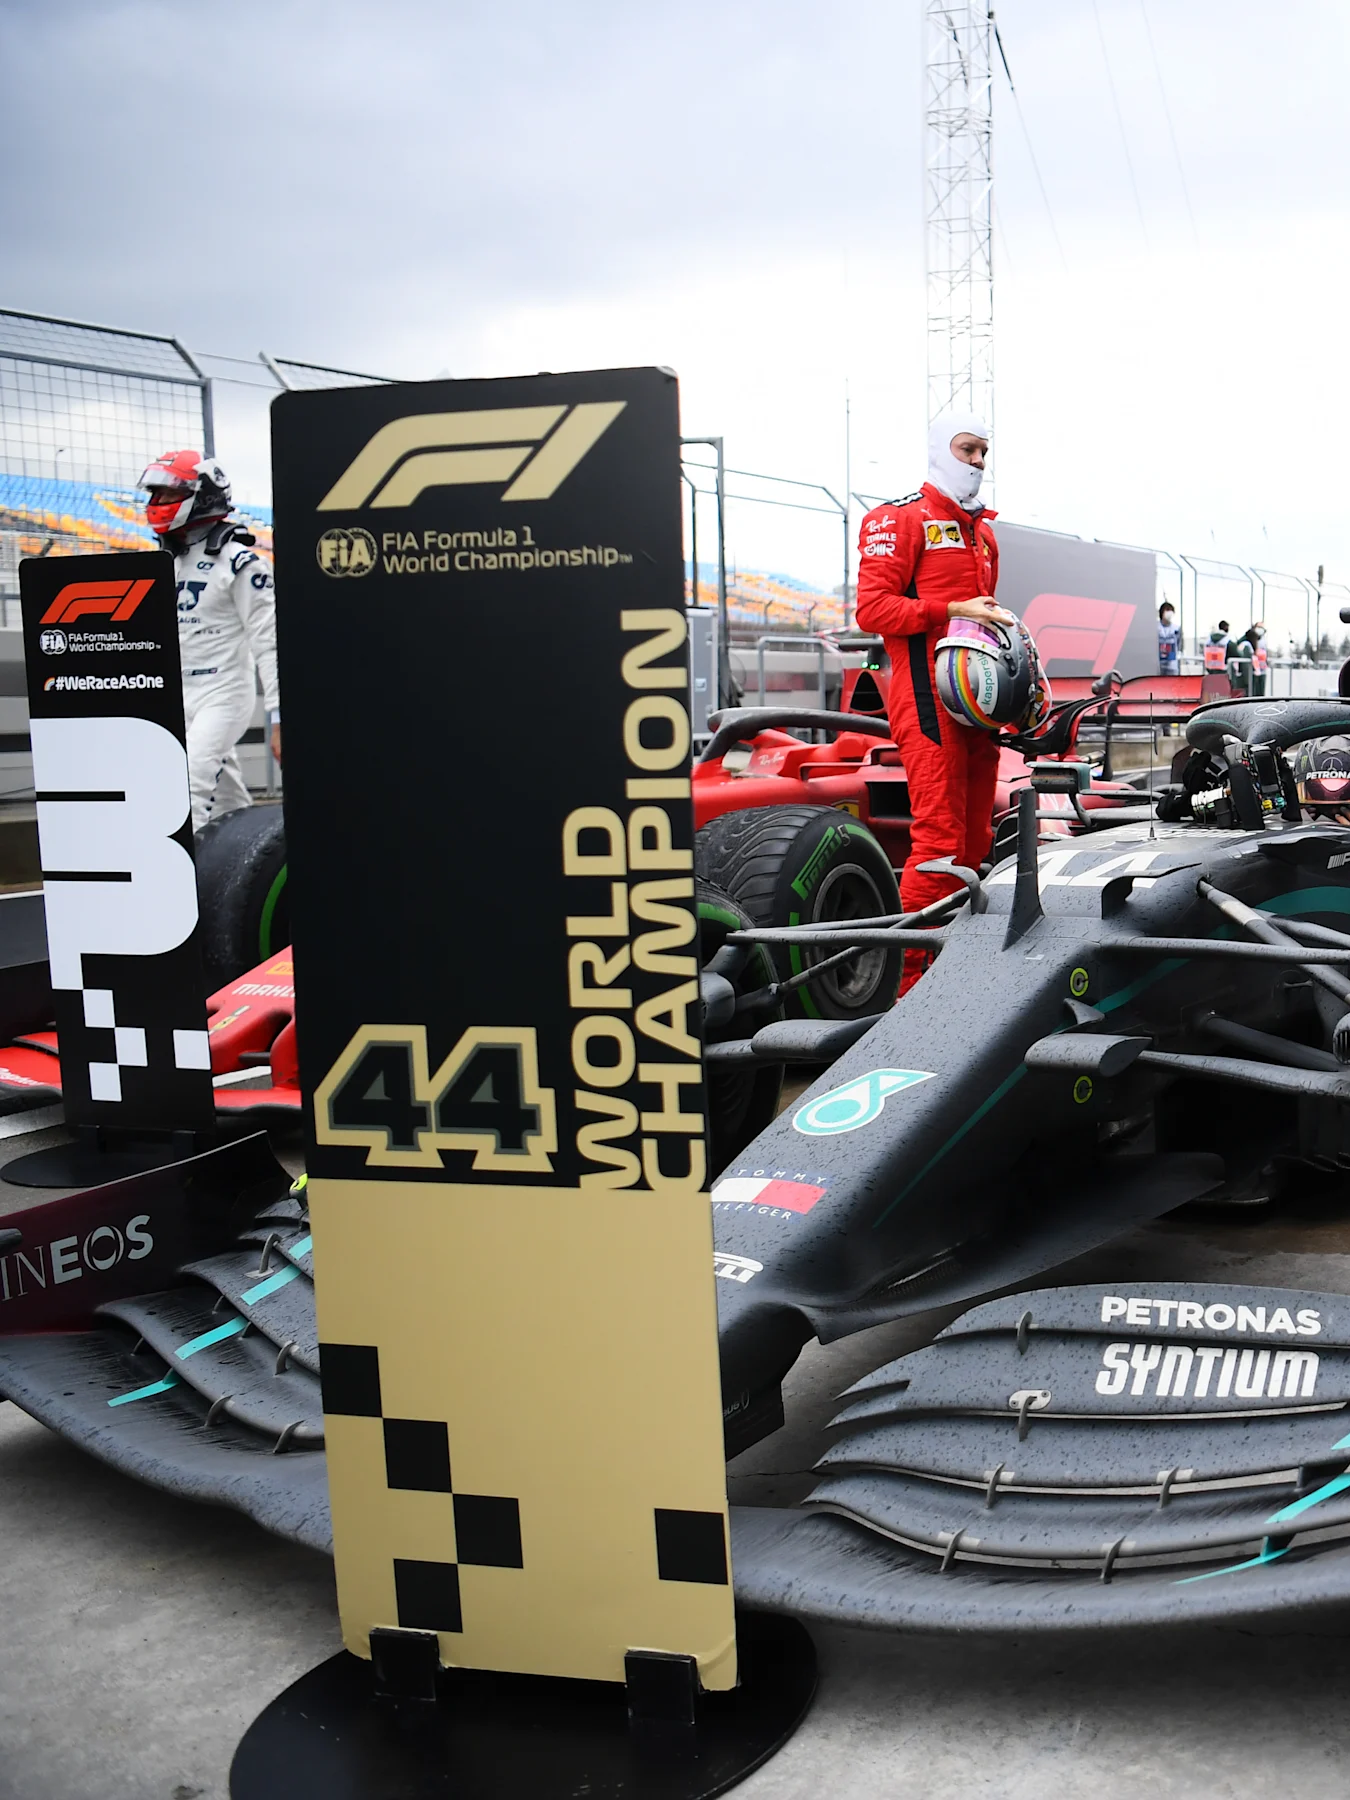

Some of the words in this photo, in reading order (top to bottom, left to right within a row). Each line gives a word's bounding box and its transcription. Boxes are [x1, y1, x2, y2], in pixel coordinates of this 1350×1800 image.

[382, 532, 419, 551] FIA
[423, 528, 518, 551] Formula
[521, 525, 536, 546] 1
[383, 551, 449, 574] World
[454, 545, 619, 571] Championship
[68, 633, 83, 643] FIA
[83, 632, 118, 642] Formula
[69, 642, 94, 652] World
[95, 640, 155, 652] Championship
[55, 674, 164, 690] #WeRaceAsOne
[620, 608, 708, 1192] CHAMPION
[231, 983, 296, 998] MAHL
[562, 805, 641, 1189] WORLD
[313, 1023, 559, 1172] 44
[737, 1169, 827, 1184] TOMMY
[713, 1203, 793, 1220] ILFIGER
[0, 1214, 154, 1301] INEOS
[1101, 1296, 1322, 1336] PETRONAS
[1095, 1342, 1320, 1398] SYNTIUM
